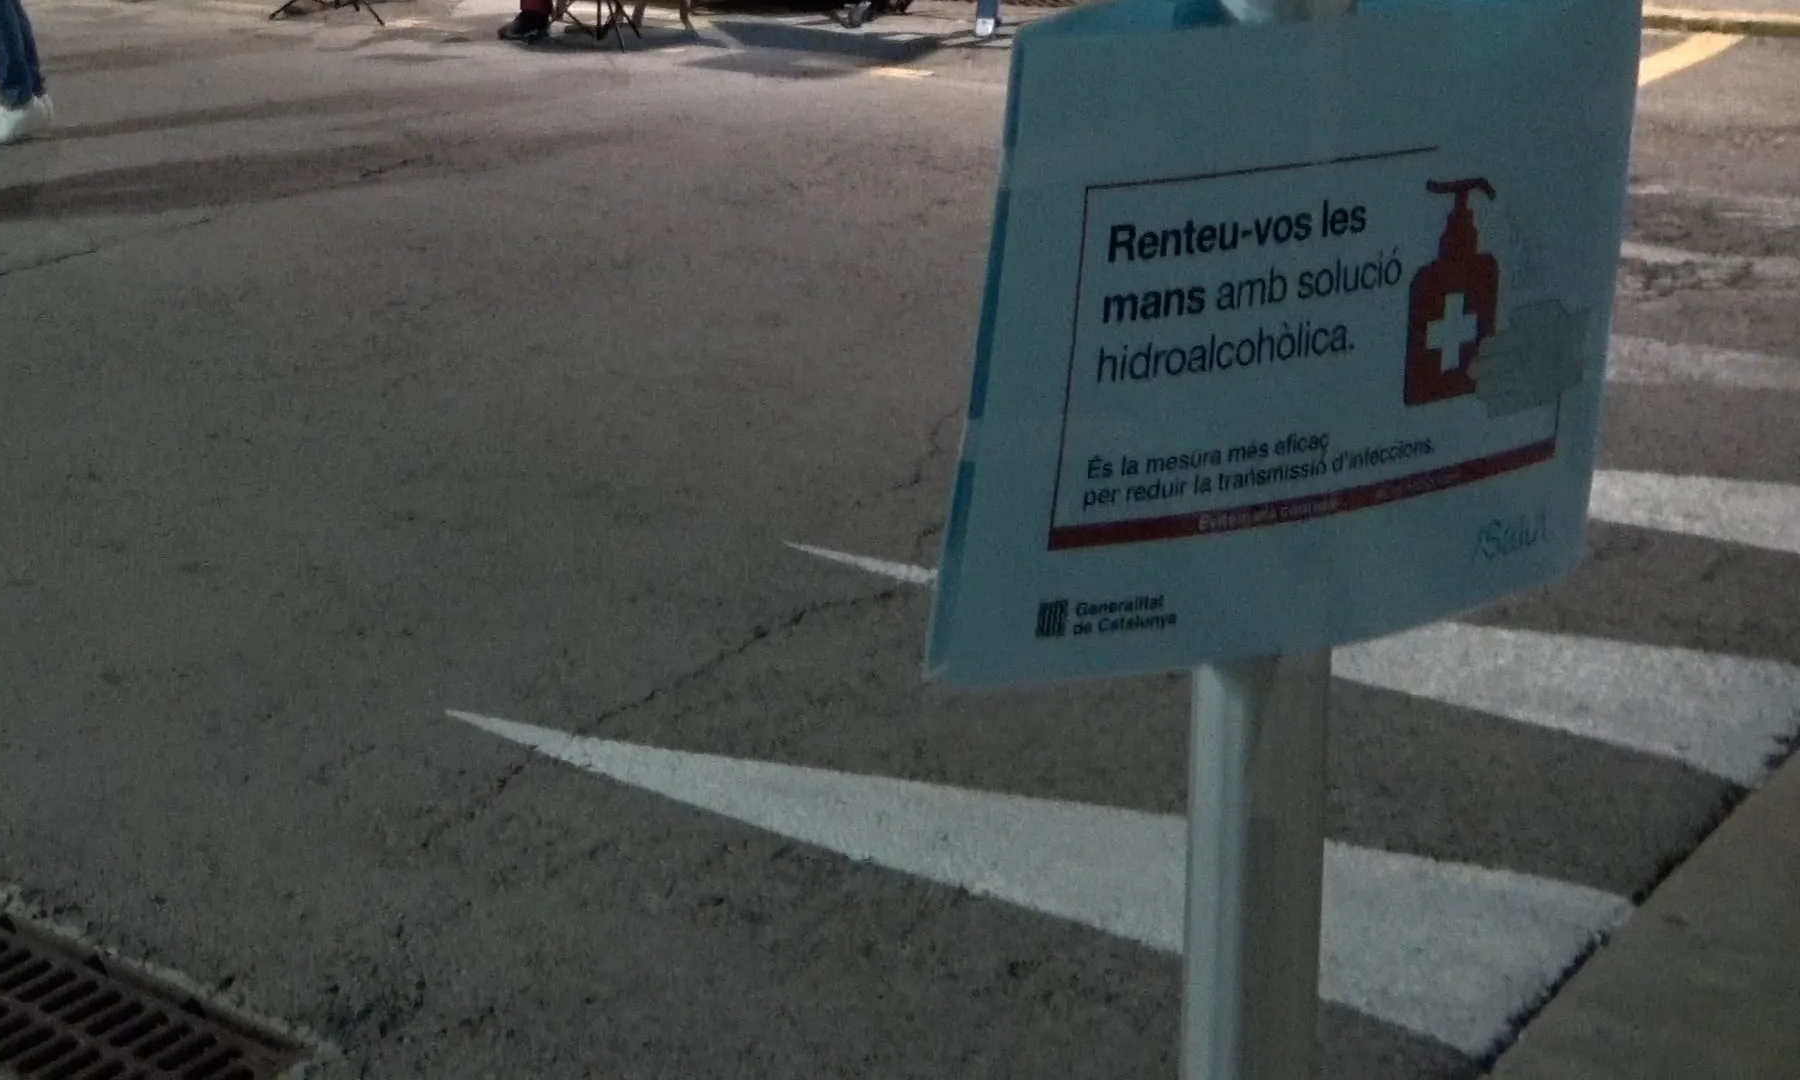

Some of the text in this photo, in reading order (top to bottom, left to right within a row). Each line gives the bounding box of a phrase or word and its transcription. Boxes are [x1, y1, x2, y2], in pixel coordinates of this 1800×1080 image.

[1108, 200, 1367, 263] Renteu-vos les
[1102, 246, 1403, 324] mans amb solució
[1096, 321, 1355, 383] hidroalcohòlica.
[1087, 431, 1330, 480] És la mesura més eficaç
[1082, 488, 1119, 512] per
[1125, 476, 1189, 504] reduir
[1193, 475, 1212, 495] la
[1218, 458, 1328, 492] transmissió
[1072, 612, 1178, 636] de Catalunya
[1075, 594, 1165, 617] Generalitat
